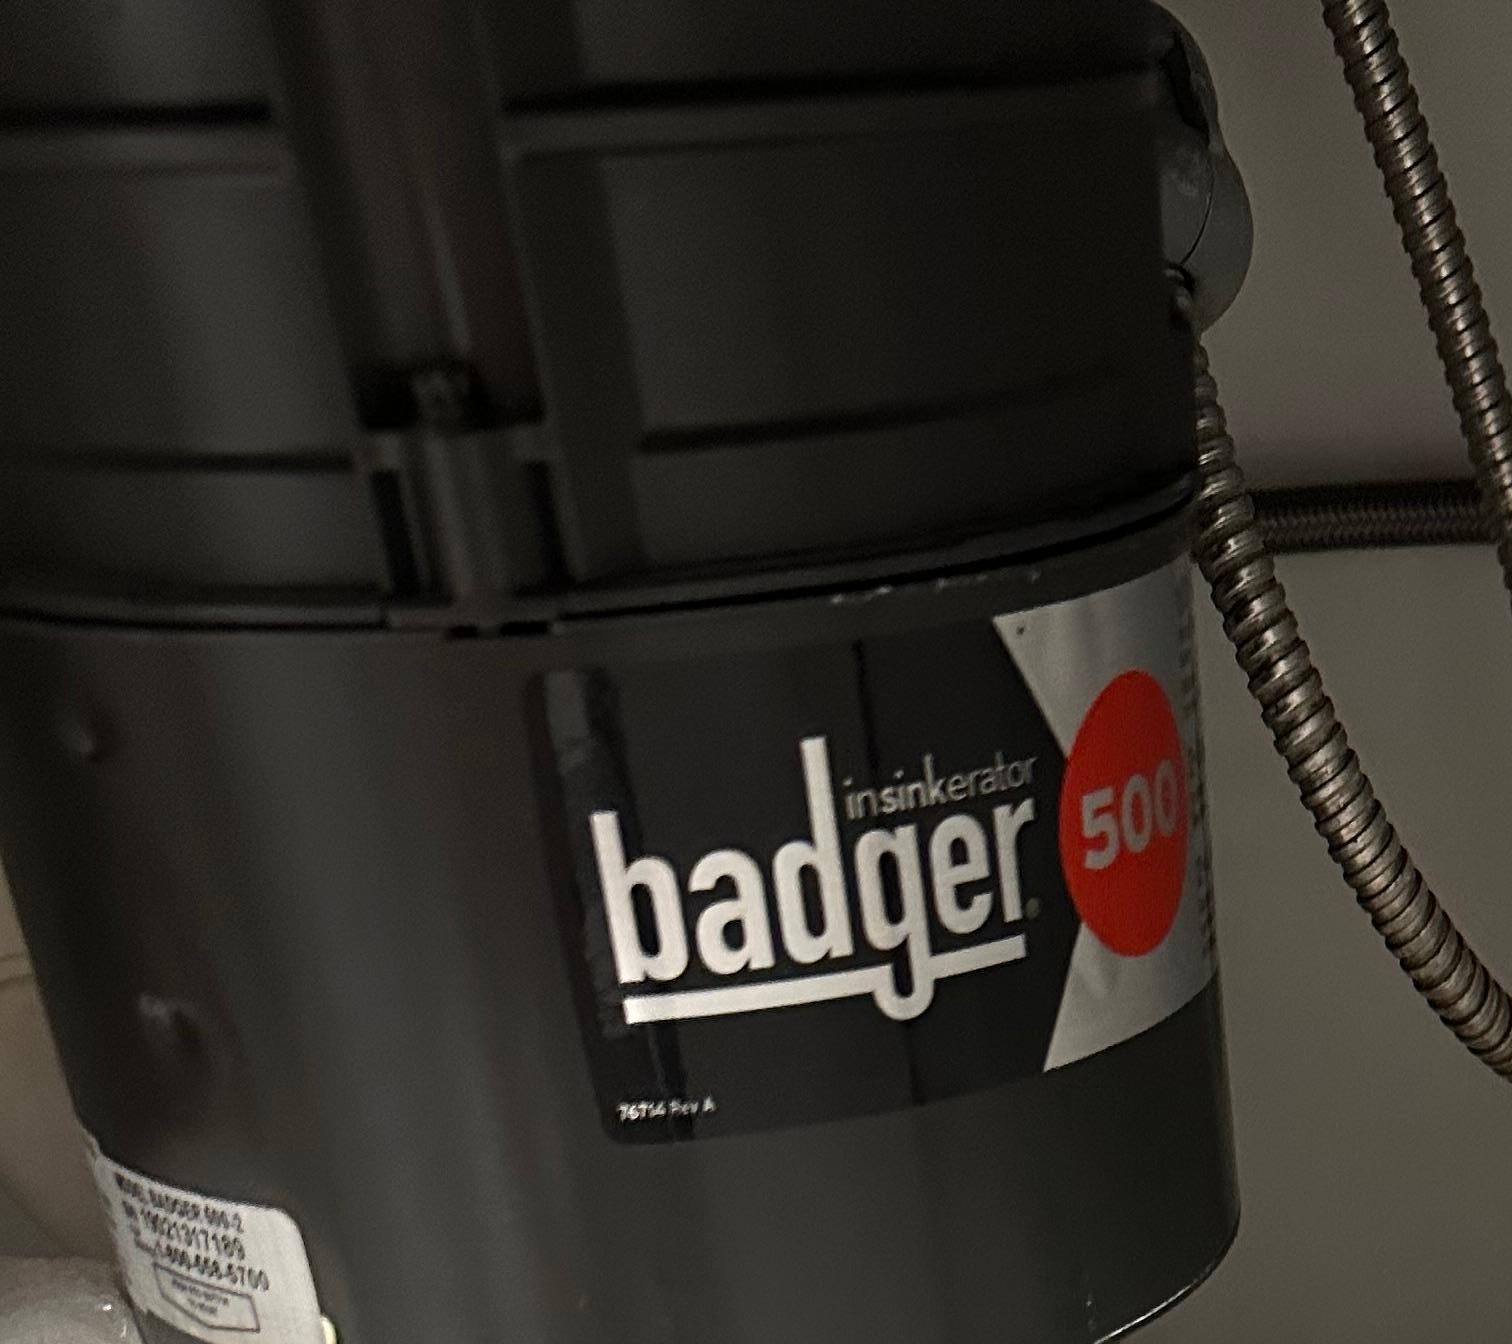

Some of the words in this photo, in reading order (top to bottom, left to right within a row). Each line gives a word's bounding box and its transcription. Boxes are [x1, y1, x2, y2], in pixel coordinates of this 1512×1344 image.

[843, 751, 1038, 820] insinkerator
[1081, 759, 1179, 870] 500
[590, 736, 1036, 1021] badger
